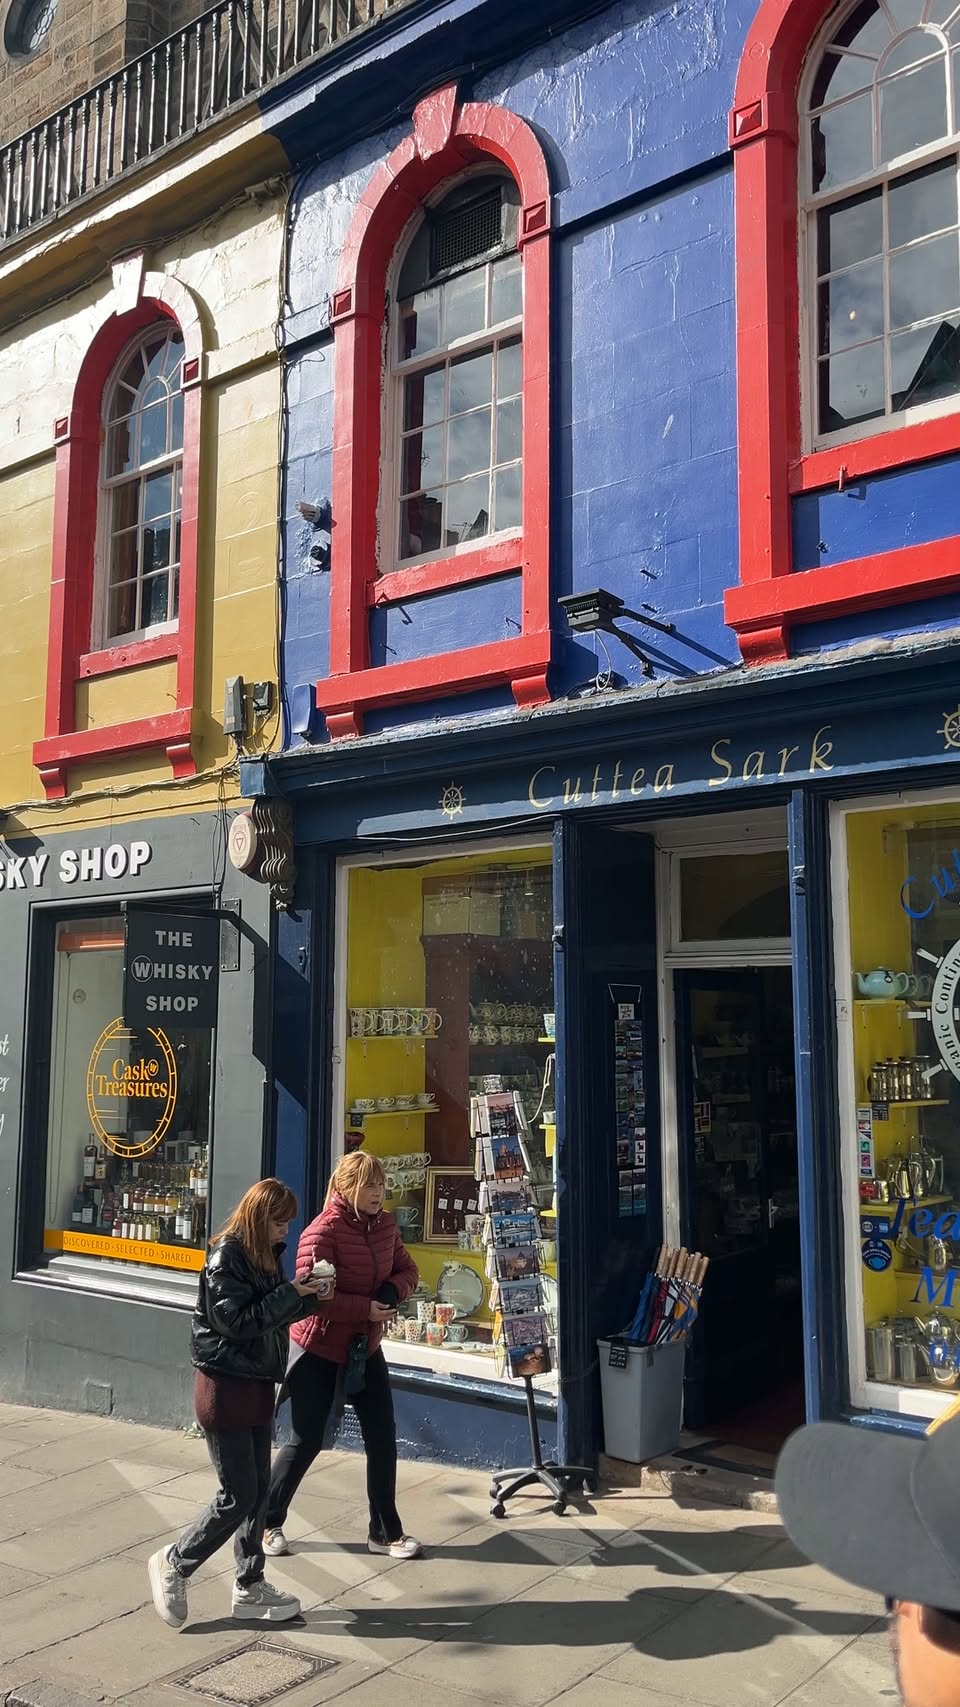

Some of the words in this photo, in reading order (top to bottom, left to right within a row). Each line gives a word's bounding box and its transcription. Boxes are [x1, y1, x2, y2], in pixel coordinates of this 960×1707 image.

[527, 759, 676, 809] Cuttea
[707, 725, 835, 787] Sark
[0, 853, 49, 890] KY
[59, 841, 151, 883] SHOP
[155, 930, 193, 947] THE
[133, 961, 214, 981] WHISKY
[145, 996, 199, 1012] SHOP
[111, 1058, 151, 1081] Cask
[96, 1074, 168, 1098] Treasures
[63, 1235, 111, 1251] DISCOVERED
[116, 1243, 155, 1258] SELECTED
[160, 1249, 192, 1264] SHARED
